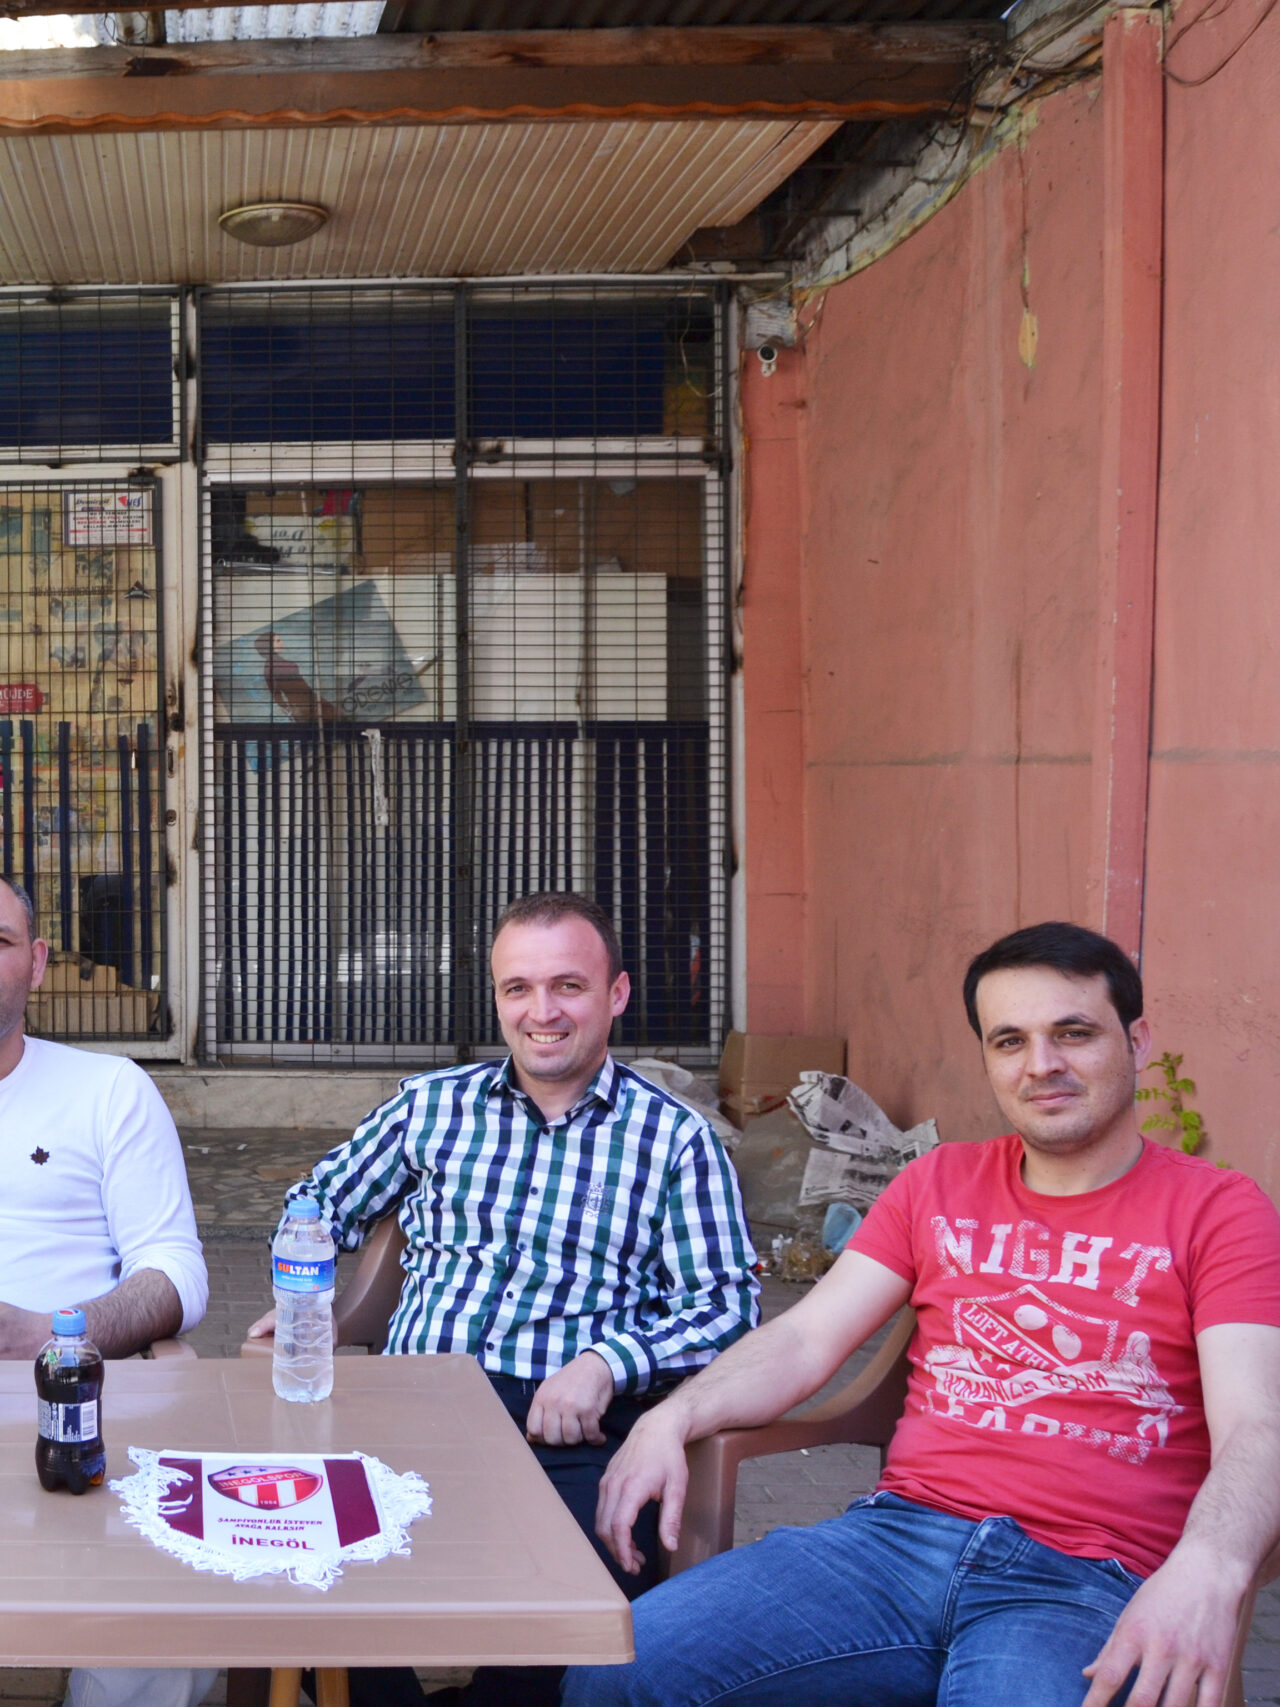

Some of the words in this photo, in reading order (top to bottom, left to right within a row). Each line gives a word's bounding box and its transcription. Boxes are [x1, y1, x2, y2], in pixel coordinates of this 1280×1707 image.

[278, 1262, 320, 1276] SULTAN
[930, 1216, 1172, 1308] NIGHT
[963, 1304, 1008, 1341] LOFT
[232, 1533, 315, 1551] İNEGÖL
